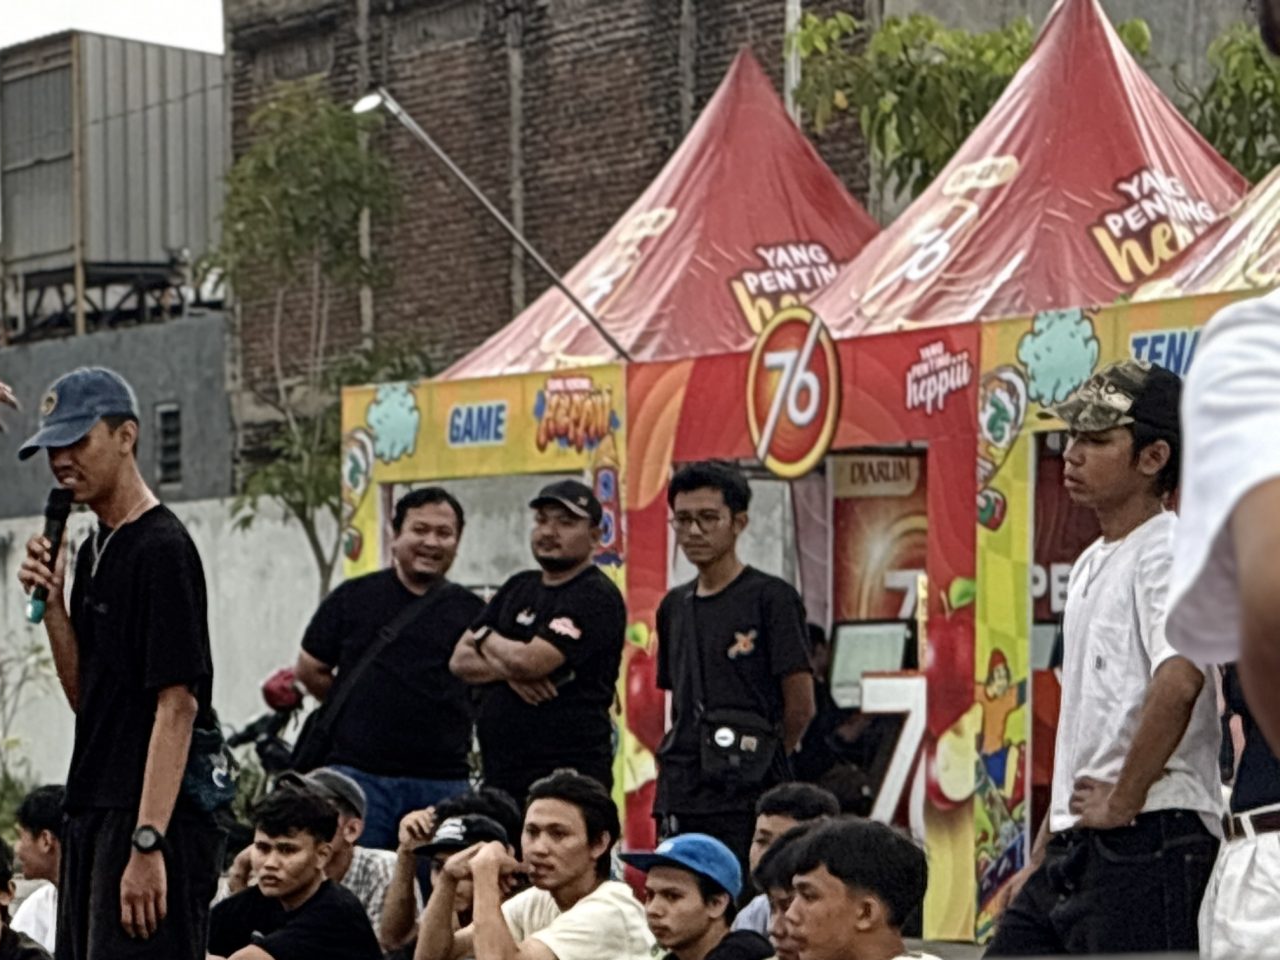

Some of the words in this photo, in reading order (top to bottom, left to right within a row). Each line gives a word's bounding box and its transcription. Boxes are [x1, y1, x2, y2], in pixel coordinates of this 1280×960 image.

[1117, 169, 1187, 199] YANG
[756, 243, 829, 269] YANG
[742, 262, 838, 295] PENTIN
[757, 315, 821, 462] 76
[449, 404, 505, 444] GAME
[850, 461, 912, 485] DJARUM
